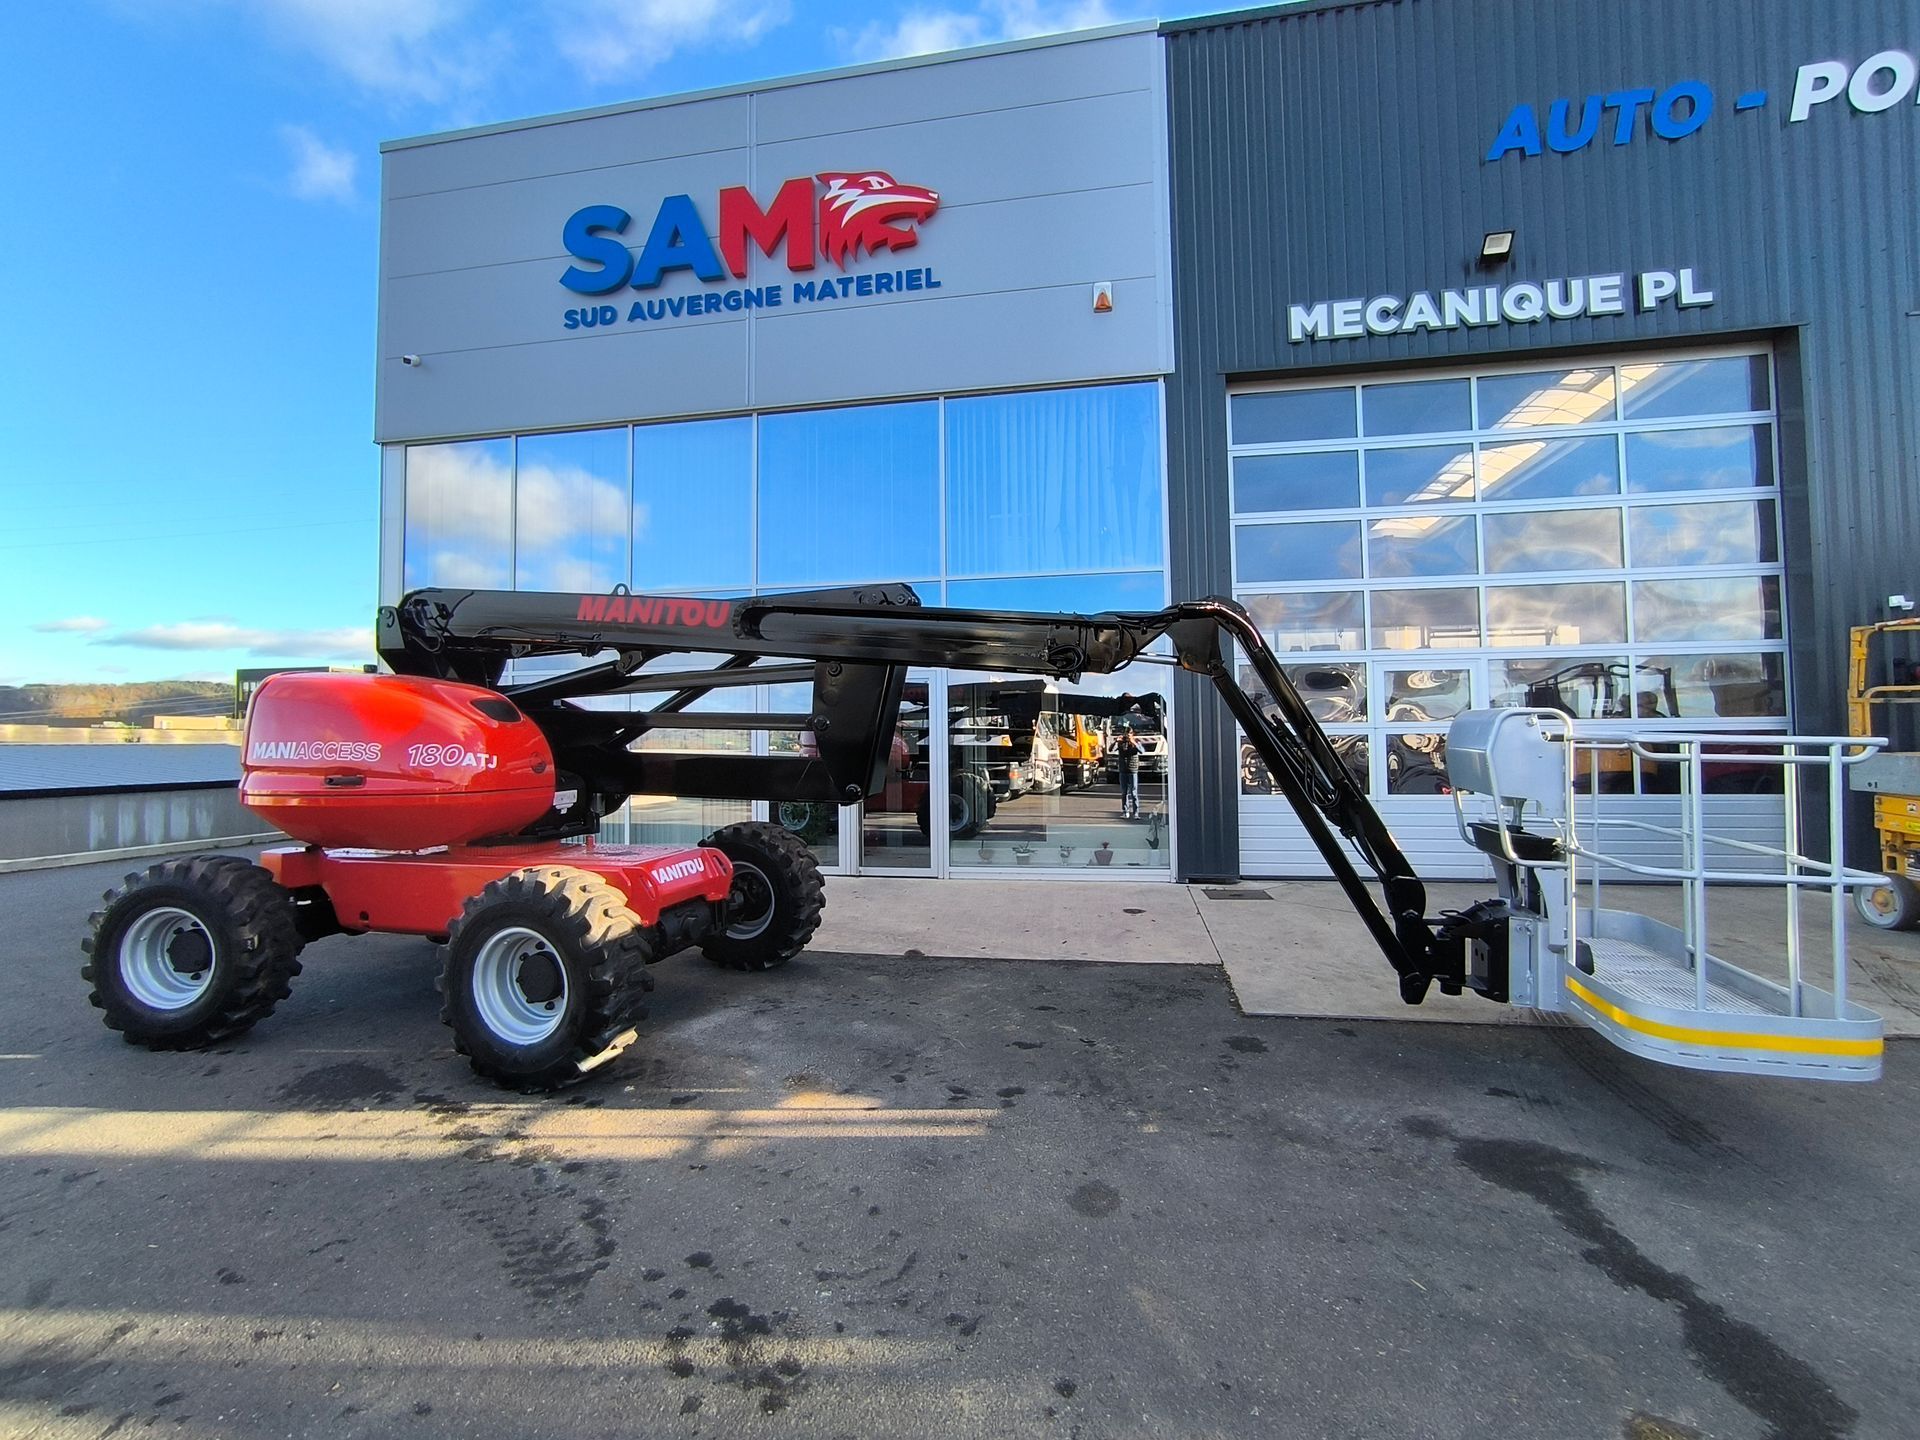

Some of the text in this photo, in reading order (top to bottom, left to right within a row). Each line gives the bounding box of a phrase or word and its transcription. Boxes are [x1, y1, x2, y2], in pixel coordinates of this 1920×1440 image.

[1485, 81, 1714, 161] AUTO
[1789, 50, 1920, 123] PO
[558, 176, 815, 297] SAM
[563, 267, 941, 330] SUD AUVERGNE MATERIEL
[1288, 268, 1714, 343] MECANIQUE PL
[576, 595, 731, 629] MANITOU
[252, 741, 382, 762] MANIACCESS
